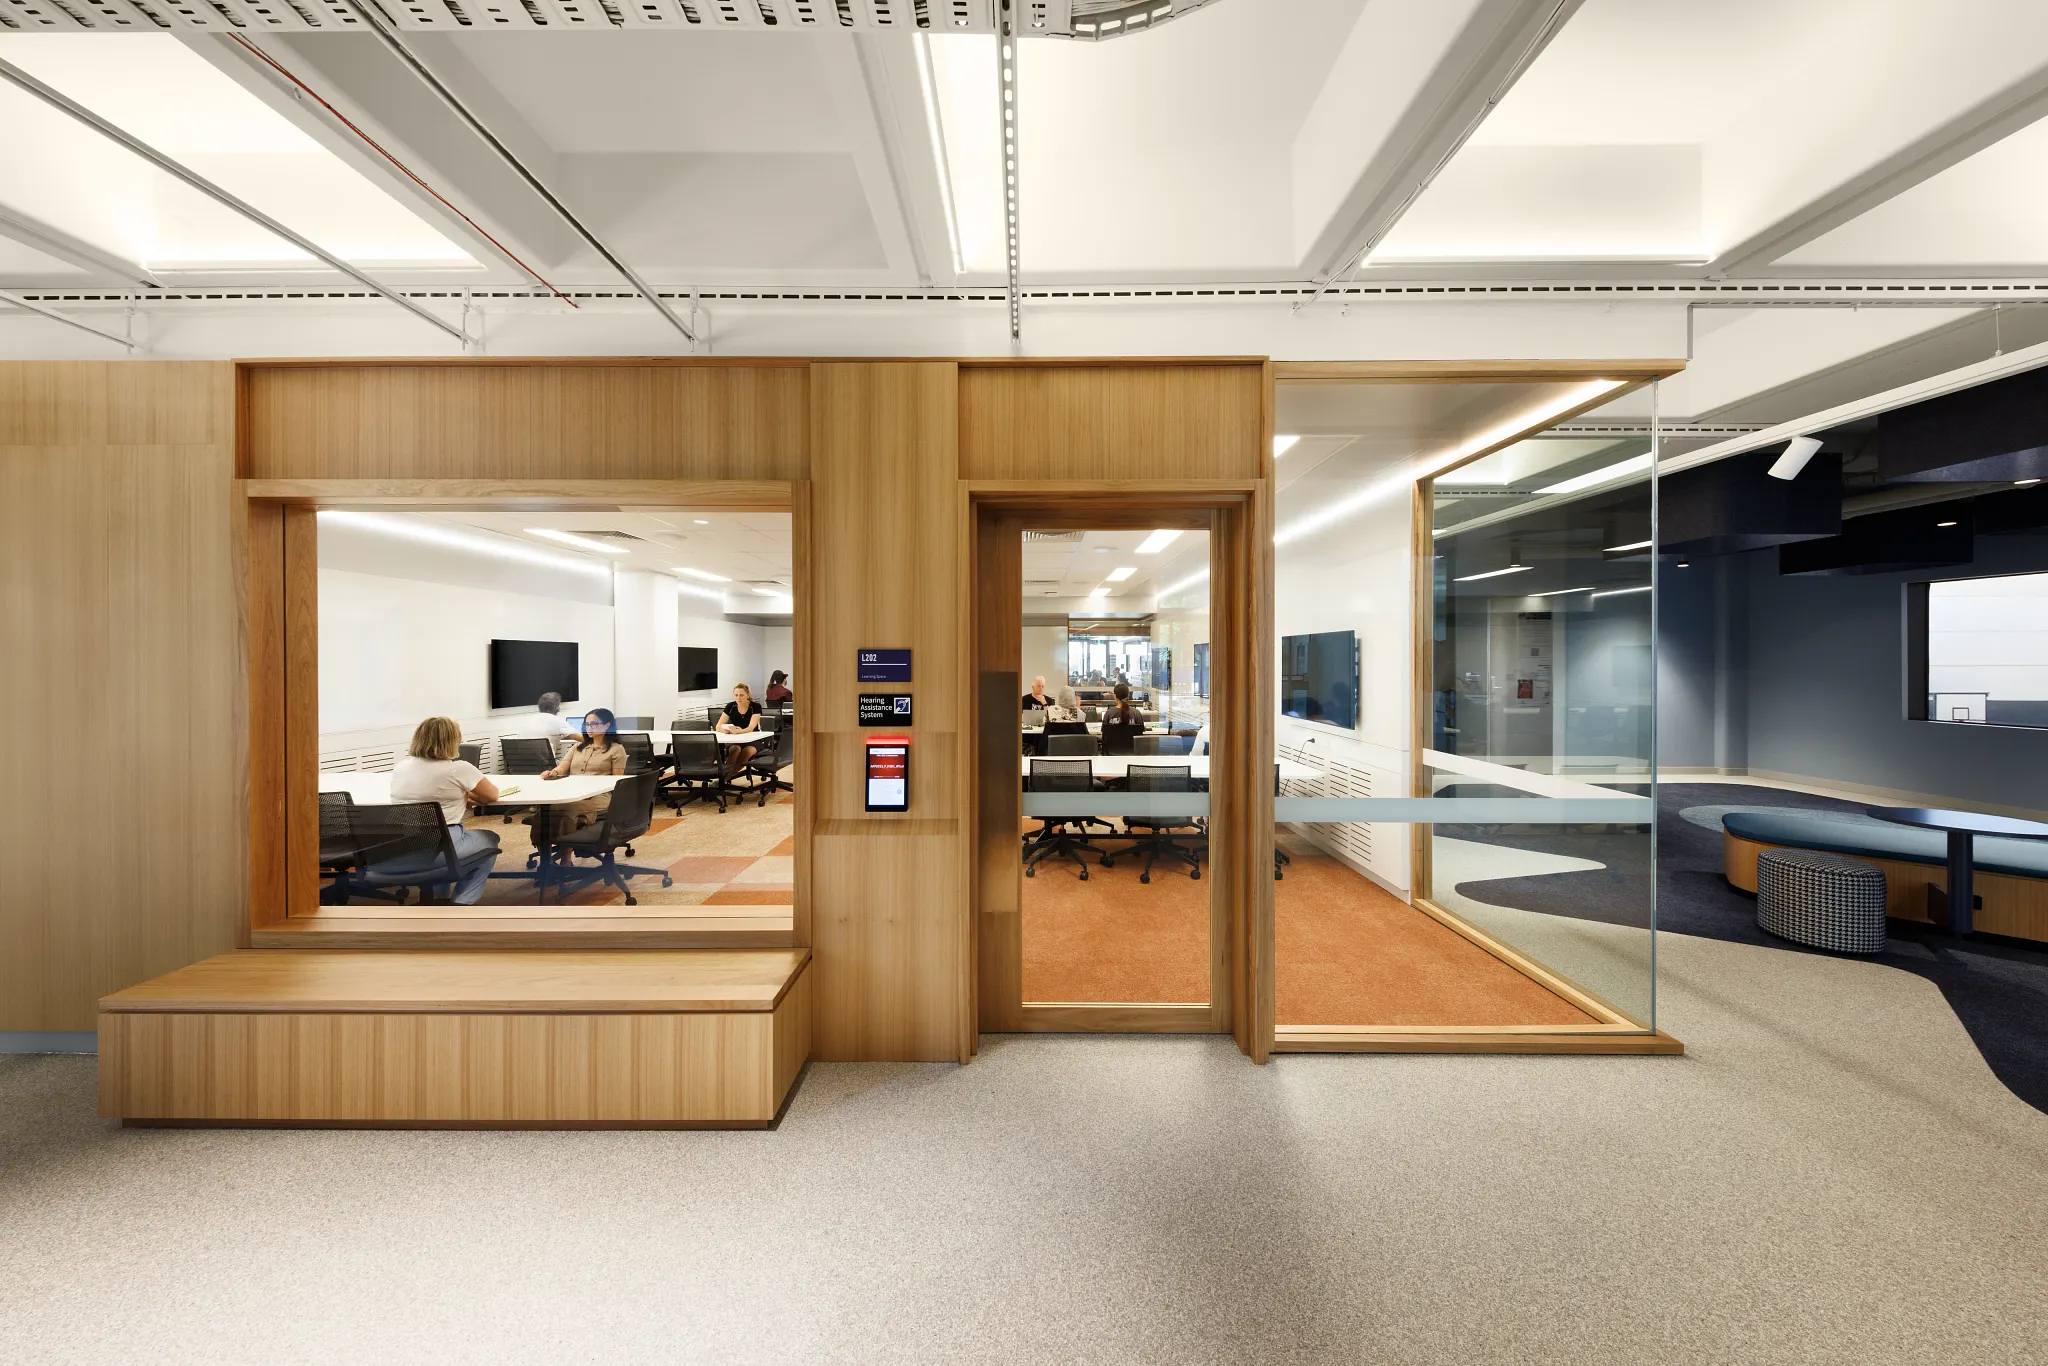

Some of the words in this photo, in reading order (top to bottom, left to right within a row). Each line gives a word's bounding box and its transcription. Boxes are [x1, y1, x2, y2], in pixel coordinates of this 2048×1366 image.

[861, 653, 877, 662] L202
[860, 697, 885, 705] Hearing
[860, 711, 883, 719] System
